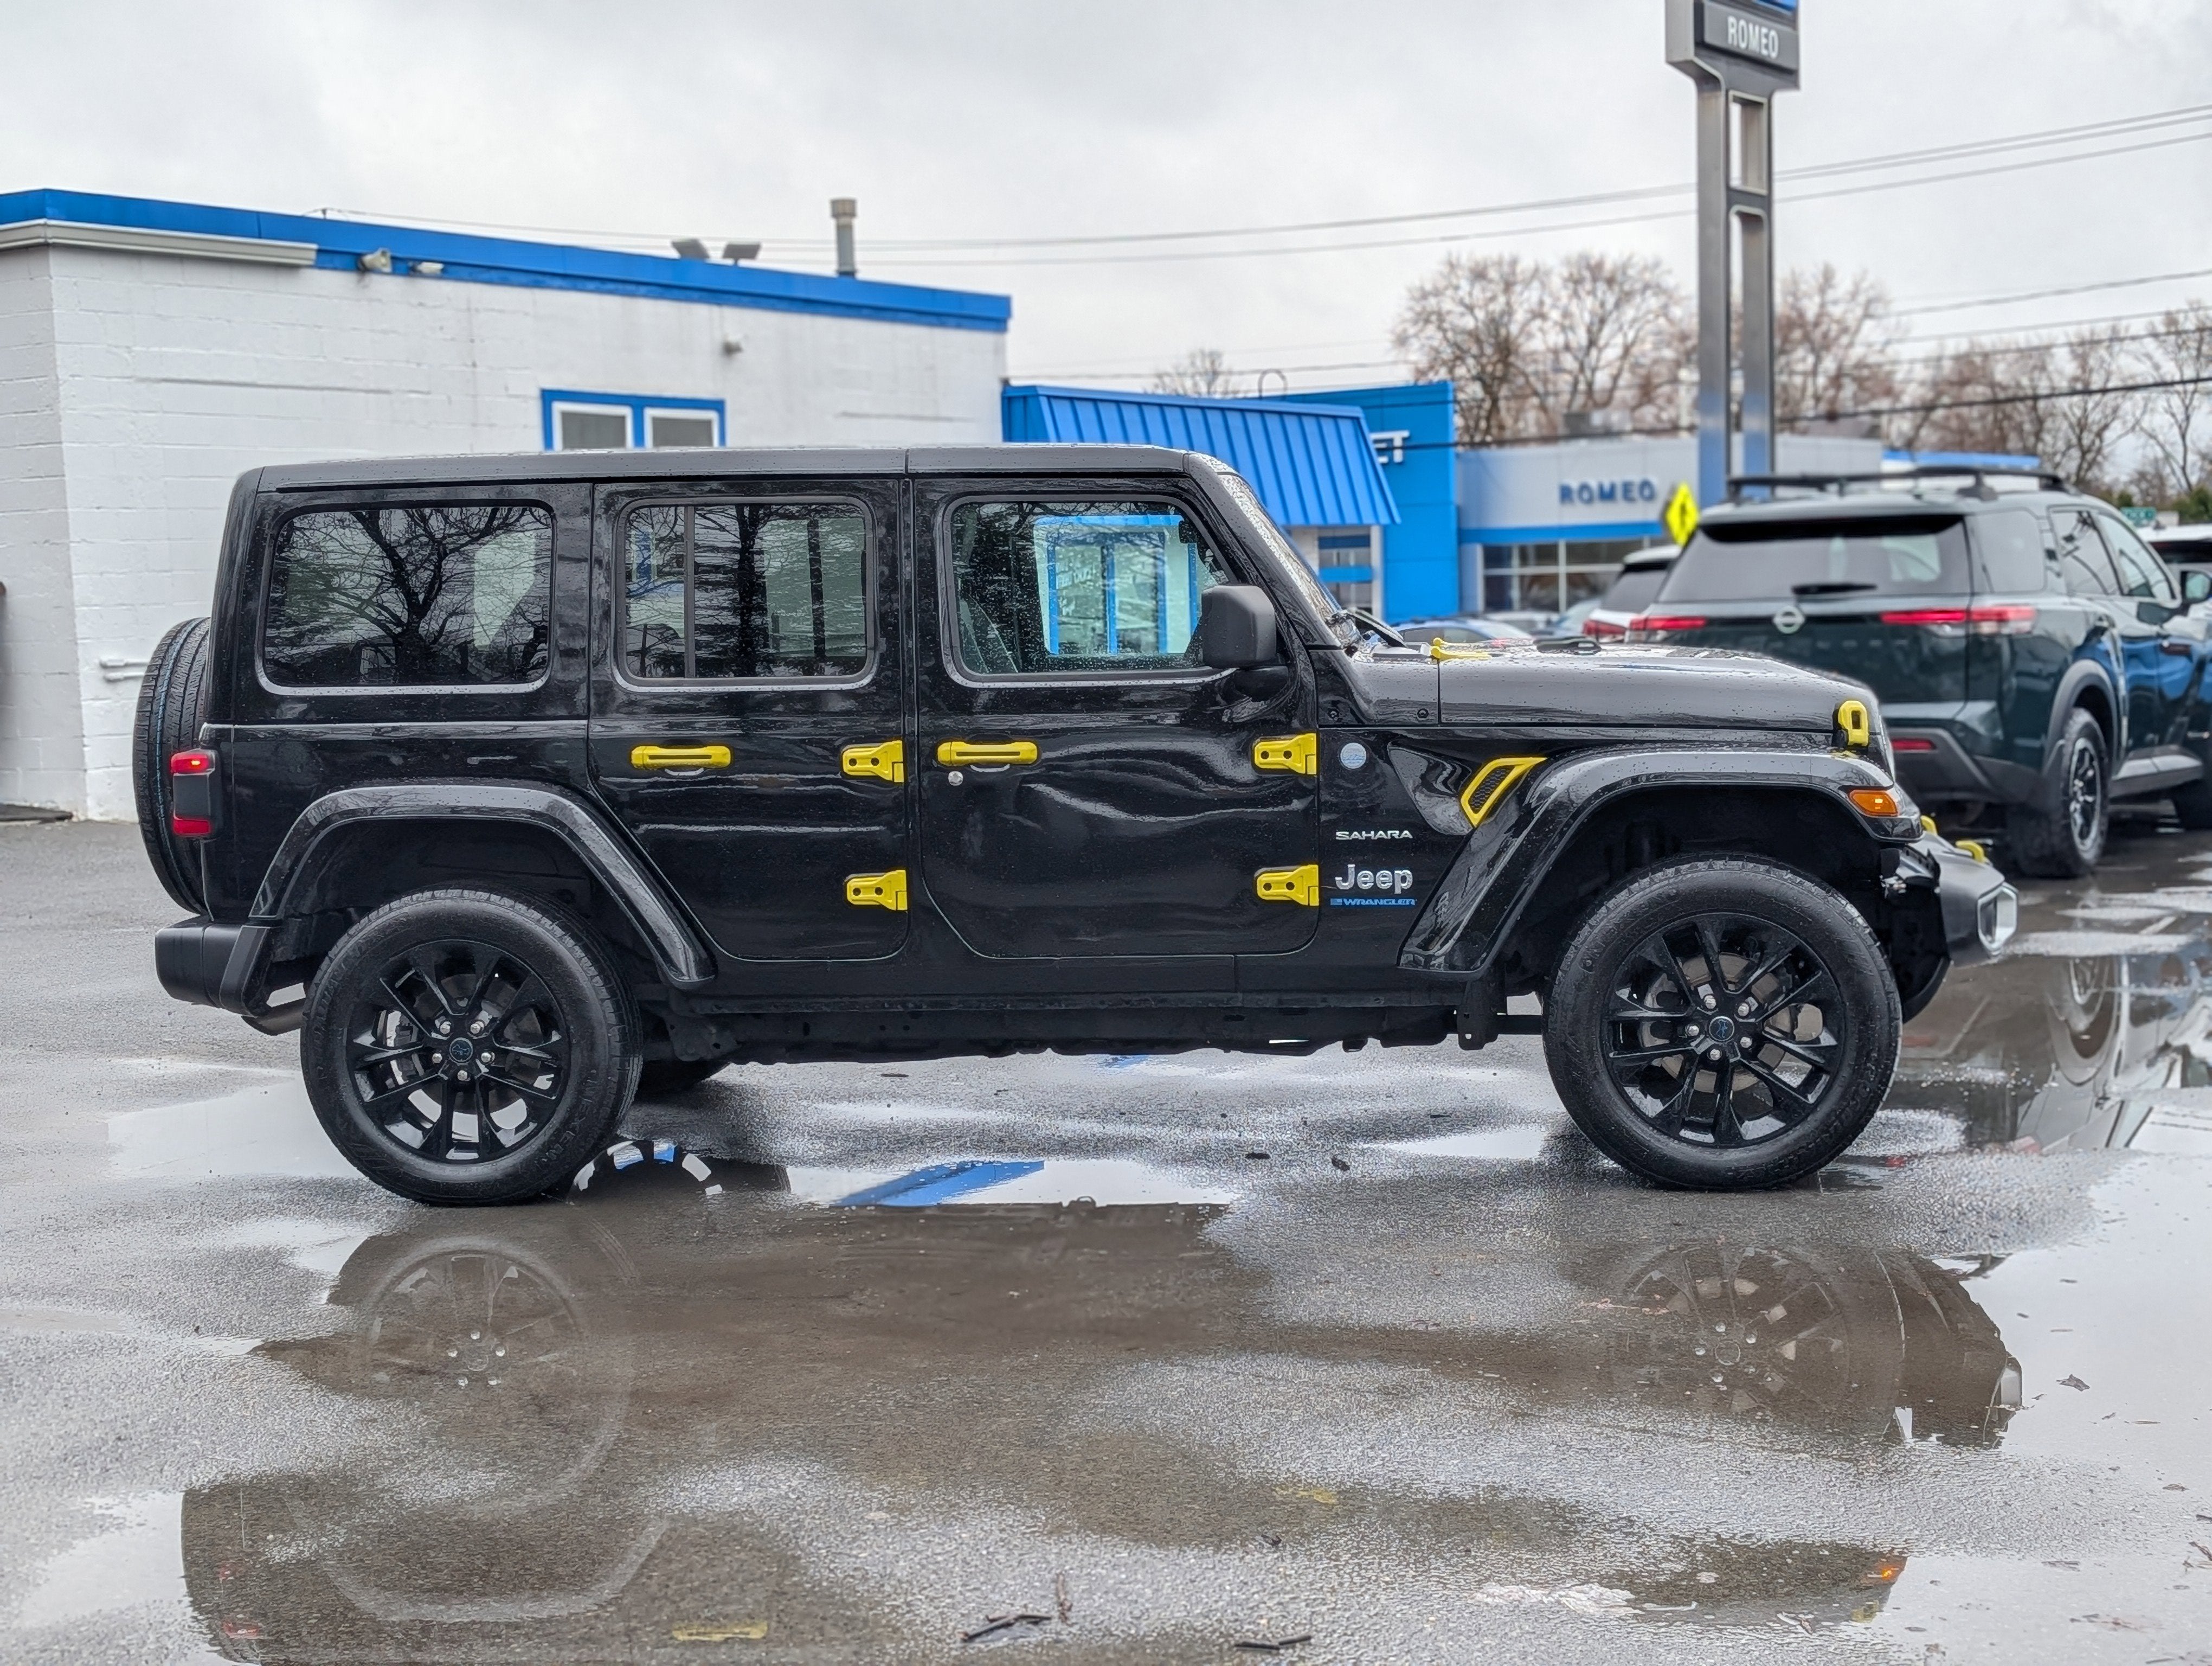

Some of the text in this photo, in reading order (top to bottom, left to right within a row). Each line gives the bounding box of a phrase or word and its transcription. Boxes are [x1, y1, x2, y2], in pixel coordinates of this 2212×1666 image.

[1727, 16, 1779, 59] ROMEO
[1559, 479, 1657, 504] ROMEO
[1335, 830, 1413, 840] SAHARA
[1335, 864, 1413, 894] Jeep
